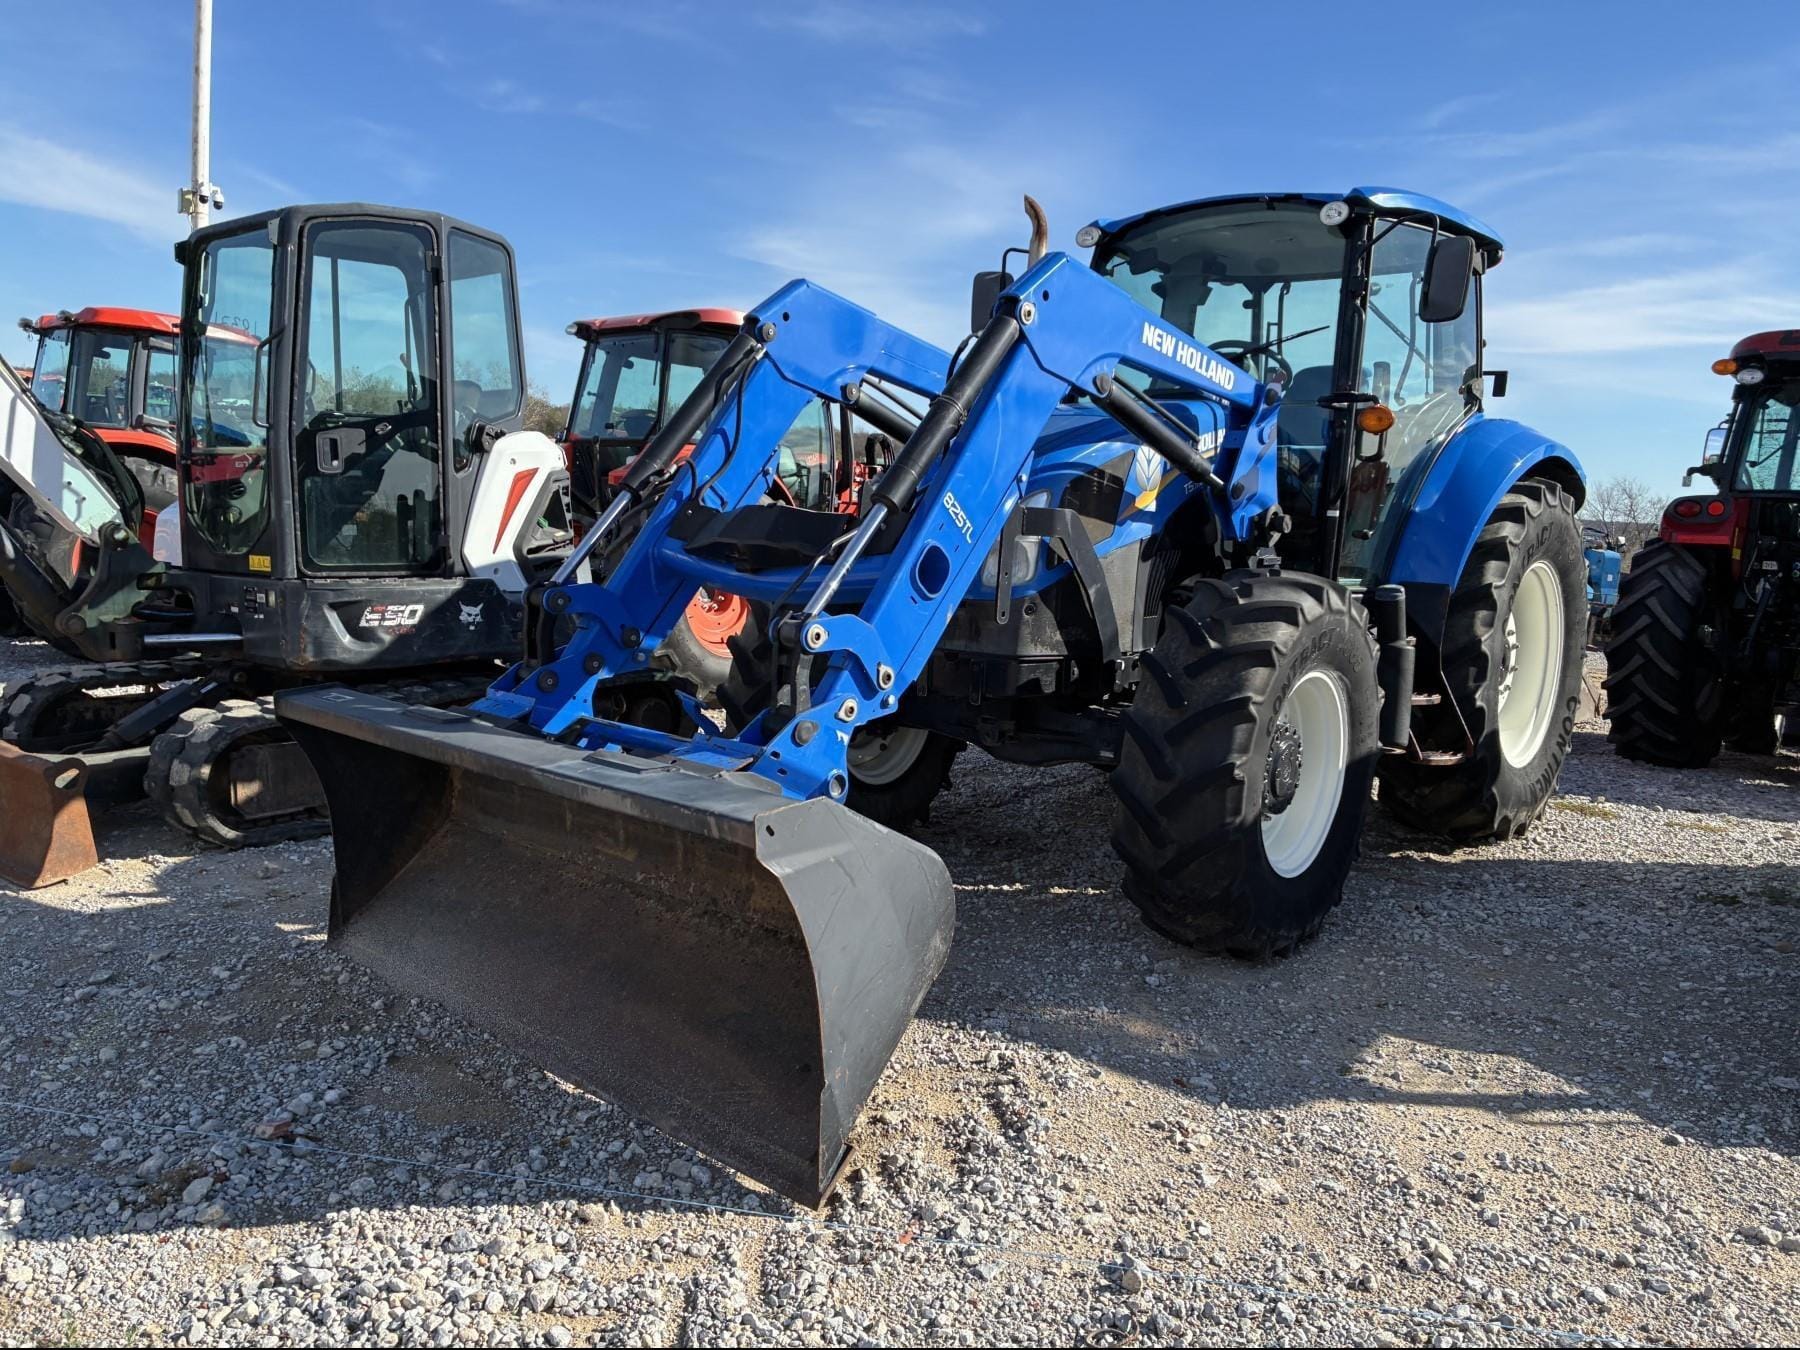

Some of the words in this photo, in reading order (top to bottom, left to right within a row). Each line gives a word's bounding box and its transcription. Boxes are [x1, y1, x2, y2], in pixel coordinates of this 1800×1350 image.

[1142, 321, 1176, 358] NEW
[1176, 340, 1235, 391] HOLLAND
[943, 491, 973, 543] 825TL
[359, 604, 425, 627] E50
[1526, 695, 1578, 803] CONTINEN
